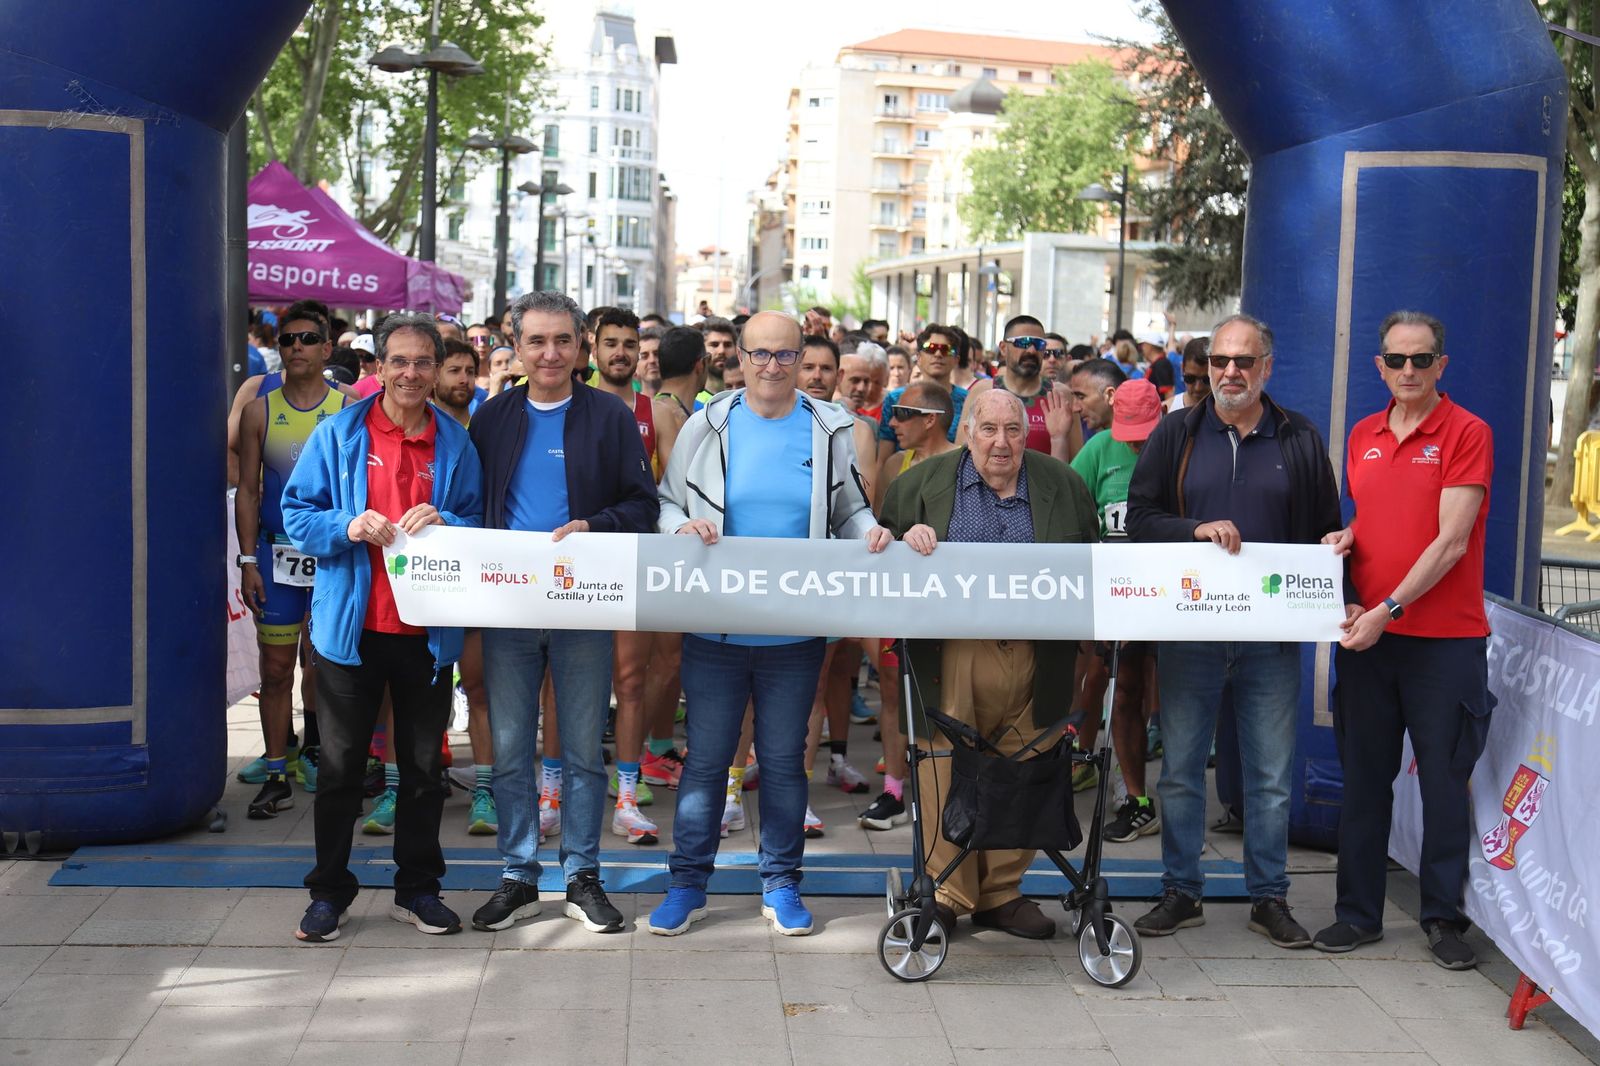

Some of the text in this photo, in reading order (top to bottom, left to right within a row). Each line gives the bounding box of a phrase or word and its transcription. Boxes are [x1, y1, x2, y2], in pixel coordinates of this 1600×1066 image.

[412, 555, 461, 572] Plena
[481, 562, 503, 571] NOS
[411, 571, 461, 582] inclusión
[481, 572, 538, 585] IMPULSA
[646, 560, 1084, 600] DÍA DE CASTILLA Y LEÓN
[1110, 577, 1132, 585] NOS
[1286, 573, 1334, 589] Plena
[411, 583, 440, 592] Castilla
[448, 584, 467, 593] León
[577, 580, 624, 591] Junta de
[546, 591, 624, 603] Castilla y León
[1110, 586, 1167, 599] IMPULSA
[1204, 592, 1251, 601] Junta de
[1286, 589, 1334, 599] inclusión
[1176, 602, 1251, 613] Castilla y León
[1287, 601, 1316, 609] Castilla
[1322, 601, 1341, 609] León
[1501, 645, 1600, 727] CASTILLA
